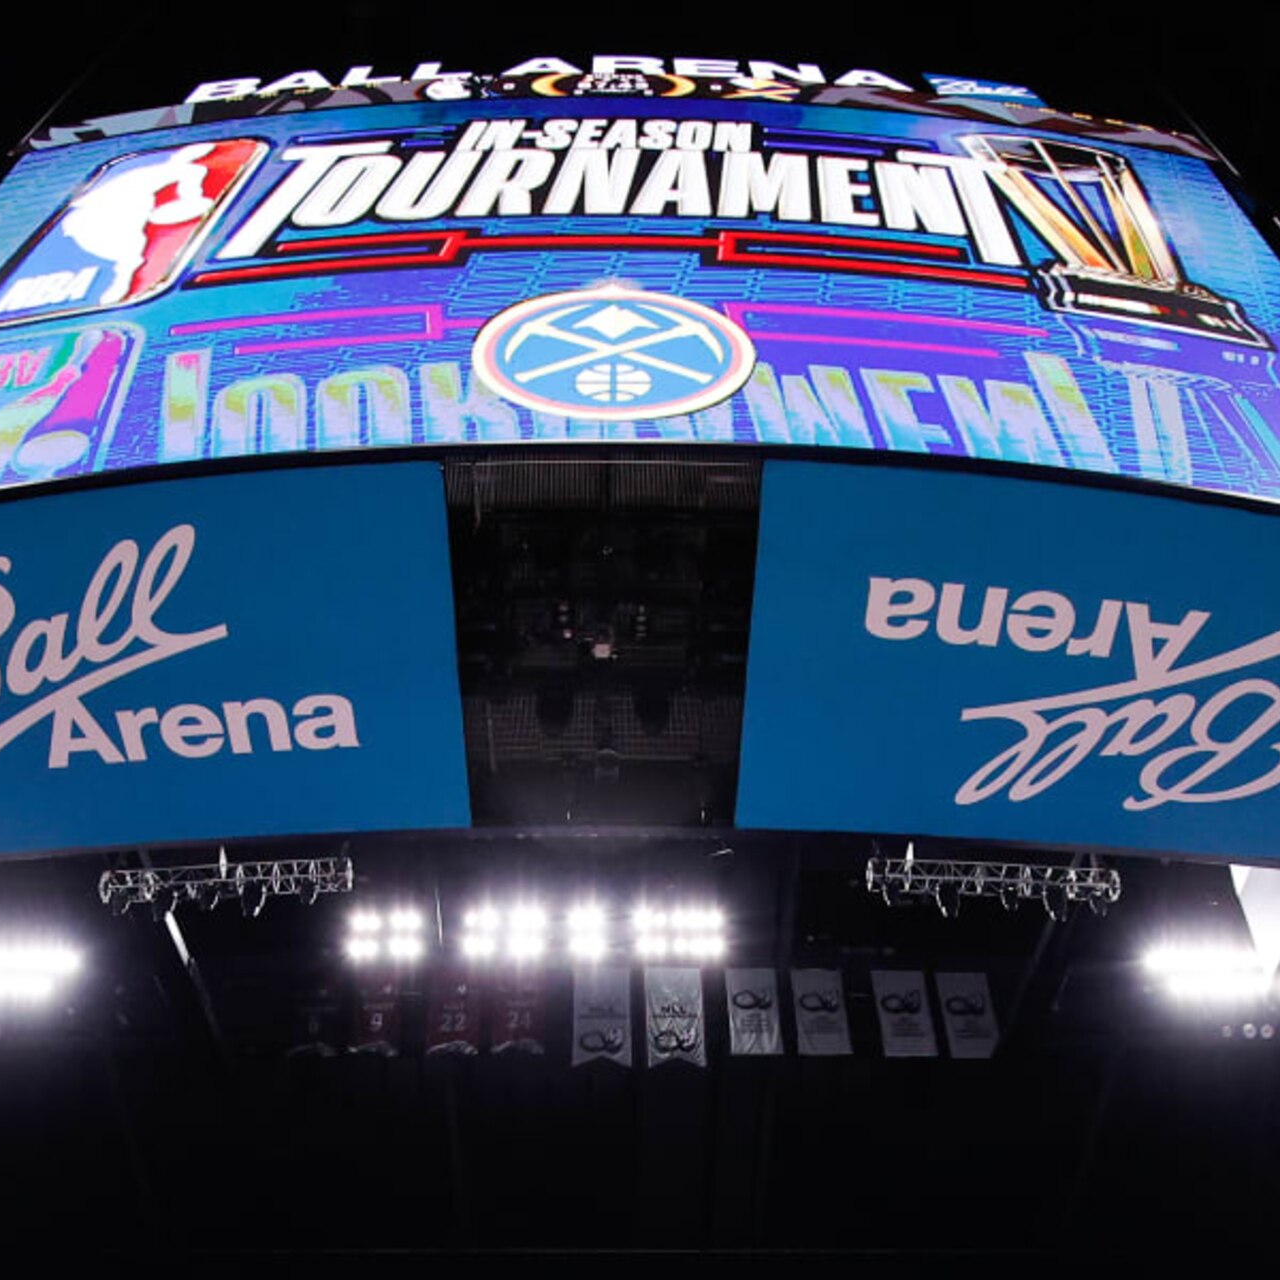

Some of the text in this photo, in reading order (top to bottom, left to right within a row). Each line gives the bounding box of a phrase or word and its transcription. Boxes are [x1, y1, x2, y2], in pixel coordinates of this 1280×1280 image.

[184, 55, 914, 101] BALL ARENA
[466, 118, 752, 152] IN-SEASON
[215, 140, 1024, 266] TOURNAMENT
[864, 576, 1211, 682] Arena
[48, 693, 360, 769] Arena
